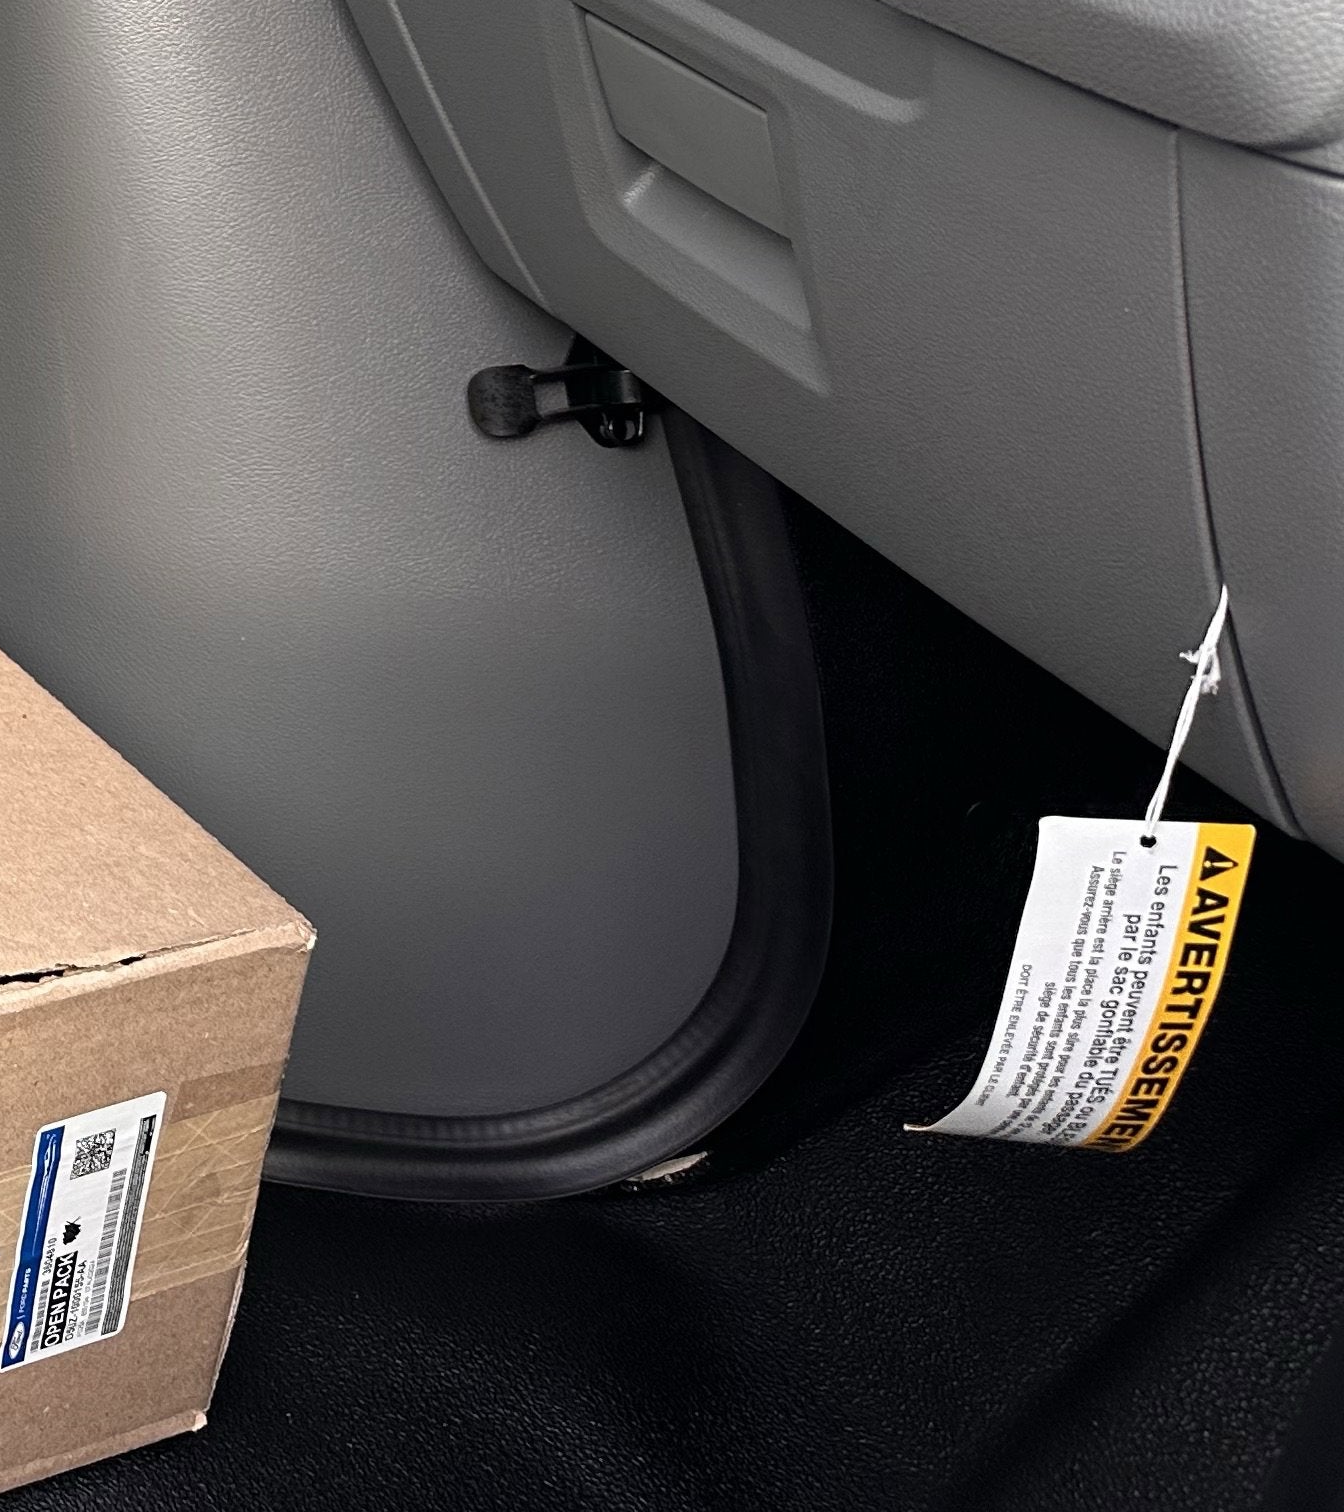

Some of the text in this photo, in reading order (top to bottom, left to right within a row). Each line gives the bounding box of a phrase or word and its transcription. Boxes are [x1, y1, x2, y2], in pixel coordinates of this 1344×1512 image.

[1112, 851, 1127, 865] Le
[1103, 867, 1124, 897] siège
[1154, 864, 1179, 896] Les
[1123, 913, 1142, 942] par
[1137, 901, 1166, 966] enfants
[1070, 937, 1086, 958] que
[1091, 937, 1105, 953] est
[1118, 947, 1139, 962] le
[1065, 960, 1082, 983] tous
[1088, 955, 1104, 966] la
[1037, 981, 1058, 1009] siège
[1060, 985, 1077, 1000] les
[1081, 967, 1098, 996] place
[1109, 966, 1129, 995] sac
[1117, 970, 1148, 1033] peuvent
[1084, 886, 1230, 1149] AVERTISSEMEN
[1083, 999, 1120, 1068] gonflable
[1104, 1036, 1132, 1065] être
[1074, 1071, 1096, 1089] du
[1086, 1068, 1120, 1105] TUÉS
[44, 1251, 76, 1347] OPEN PACK
